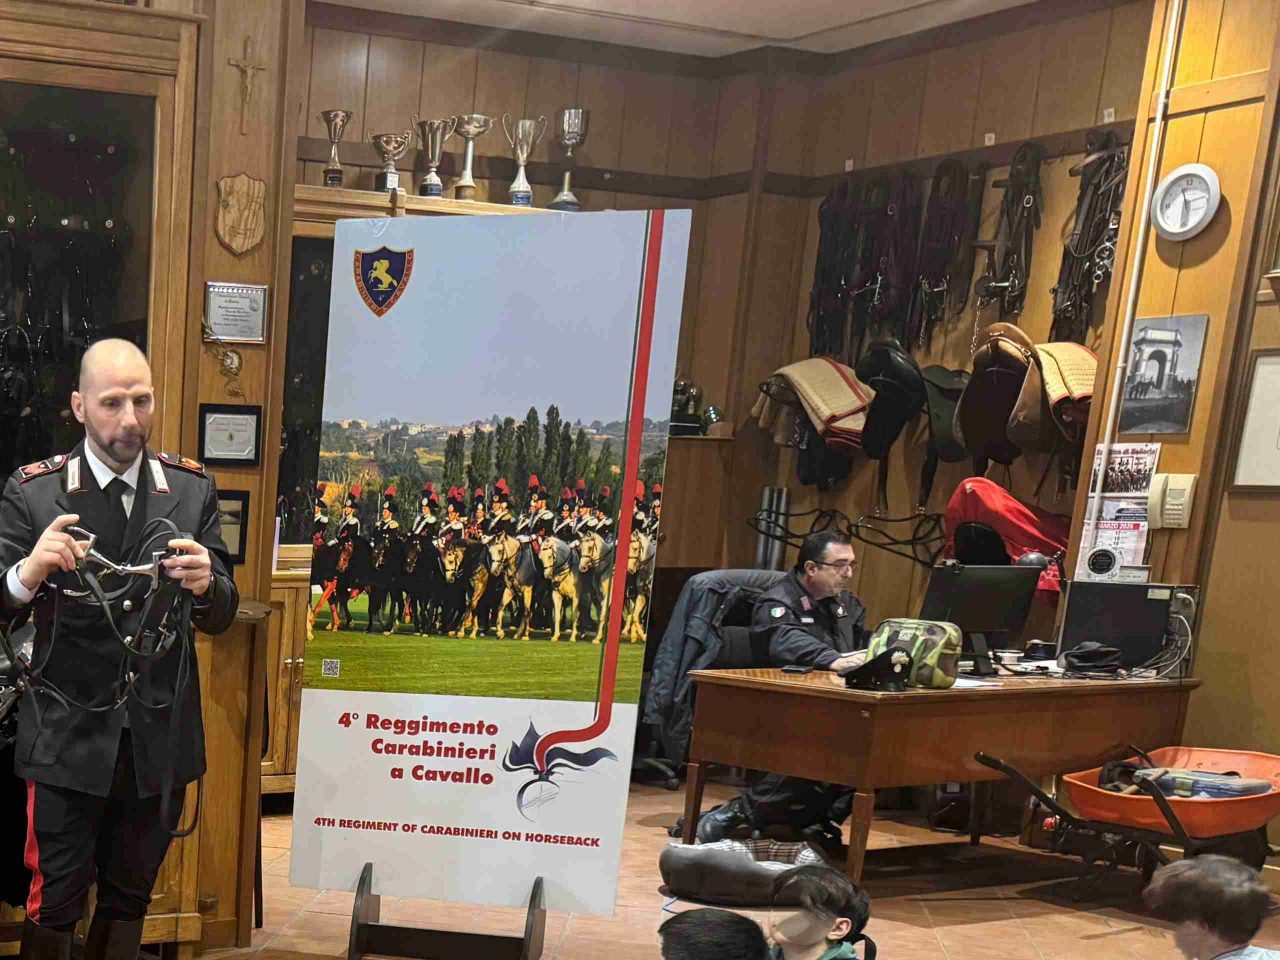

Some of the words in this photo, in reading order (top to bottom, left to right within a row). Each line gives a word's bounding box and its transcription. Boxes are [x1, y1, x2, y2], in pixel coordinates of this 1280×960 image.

[366, 713, 499, 736] Reggimento
[371, 738, 496, 761] Carabinieri
[390, 767, 404, 779] a
[411, 765, 494, 786] Cavallo
[314, 817, 336, 827] 4TH
[339, 819, 399, 832] REGIMENT
[402, 823, 418, 833] OF
[420, 825, 498, 839] CARABINIERI
[502, 831, 521, 841] ON
[525, 832, 600, 847] HORSEBACK
